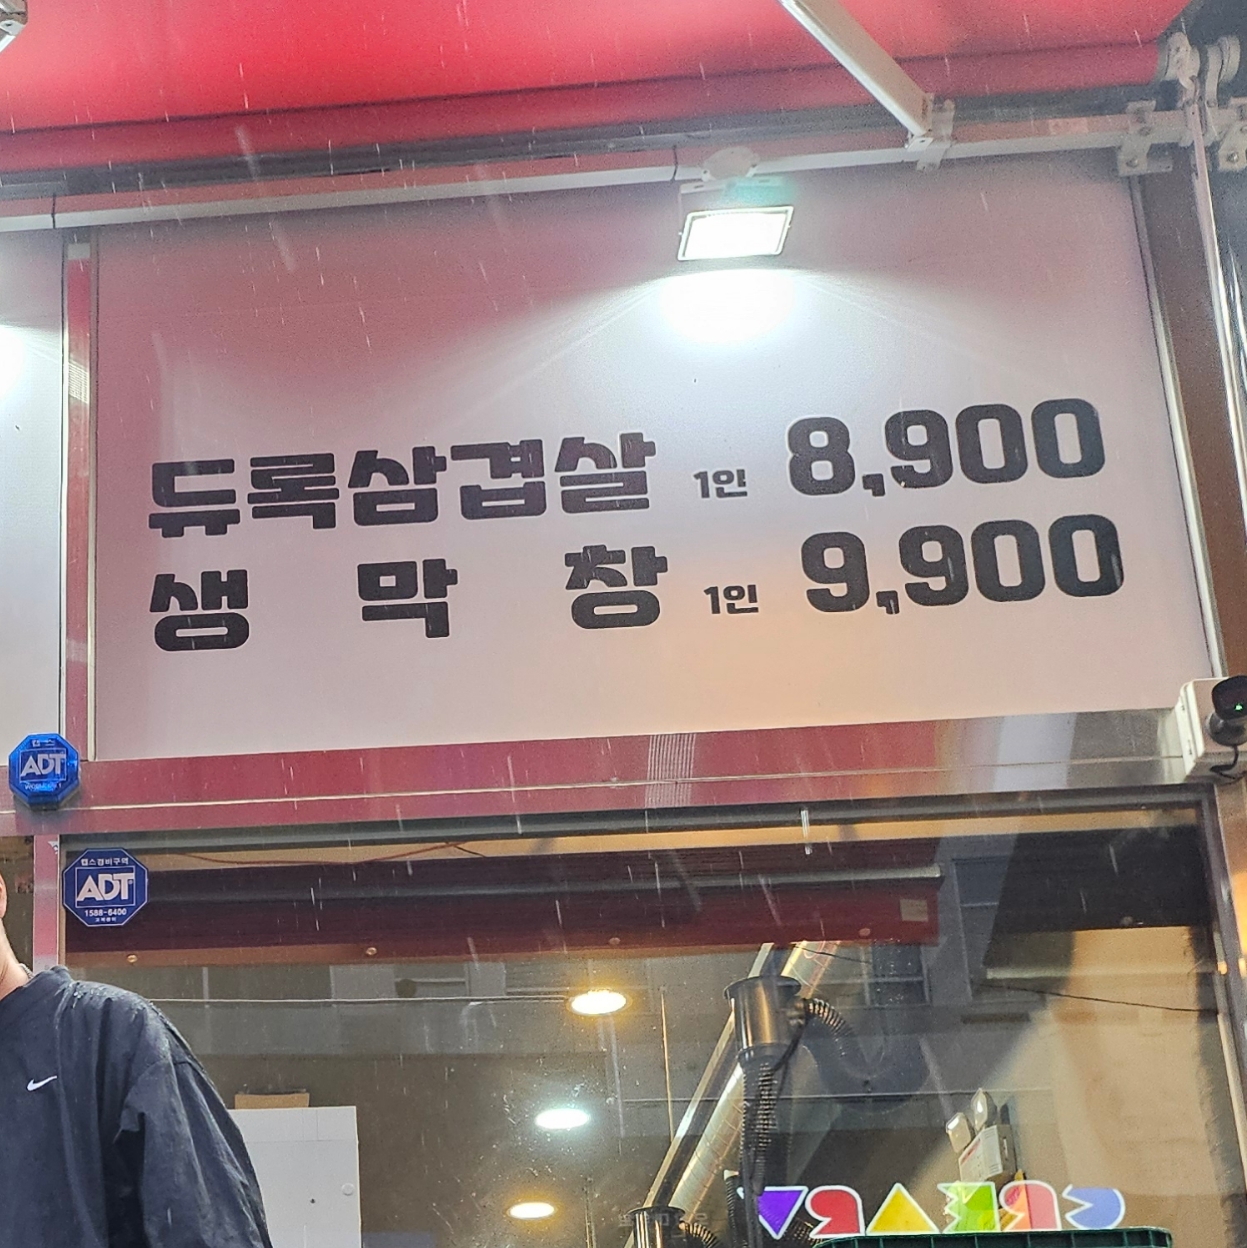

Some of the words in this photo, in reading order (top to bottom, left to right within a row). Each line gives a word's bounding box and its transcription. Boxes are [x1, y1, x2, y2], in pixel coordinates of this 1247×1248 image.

[149, 432, 655, 537] 듀록삼겹살
[693, 468, 748, 499] 1인
[787, 398, 1105, 496] 8,900
[703, 584, 759, 615] 1인
[801, 514, 1124, 615] 9,900
[20, 753, 66, 777] ADT
[76, 872, 134, 902] ADT
[85, 908, 127, 917] 1588-6400
